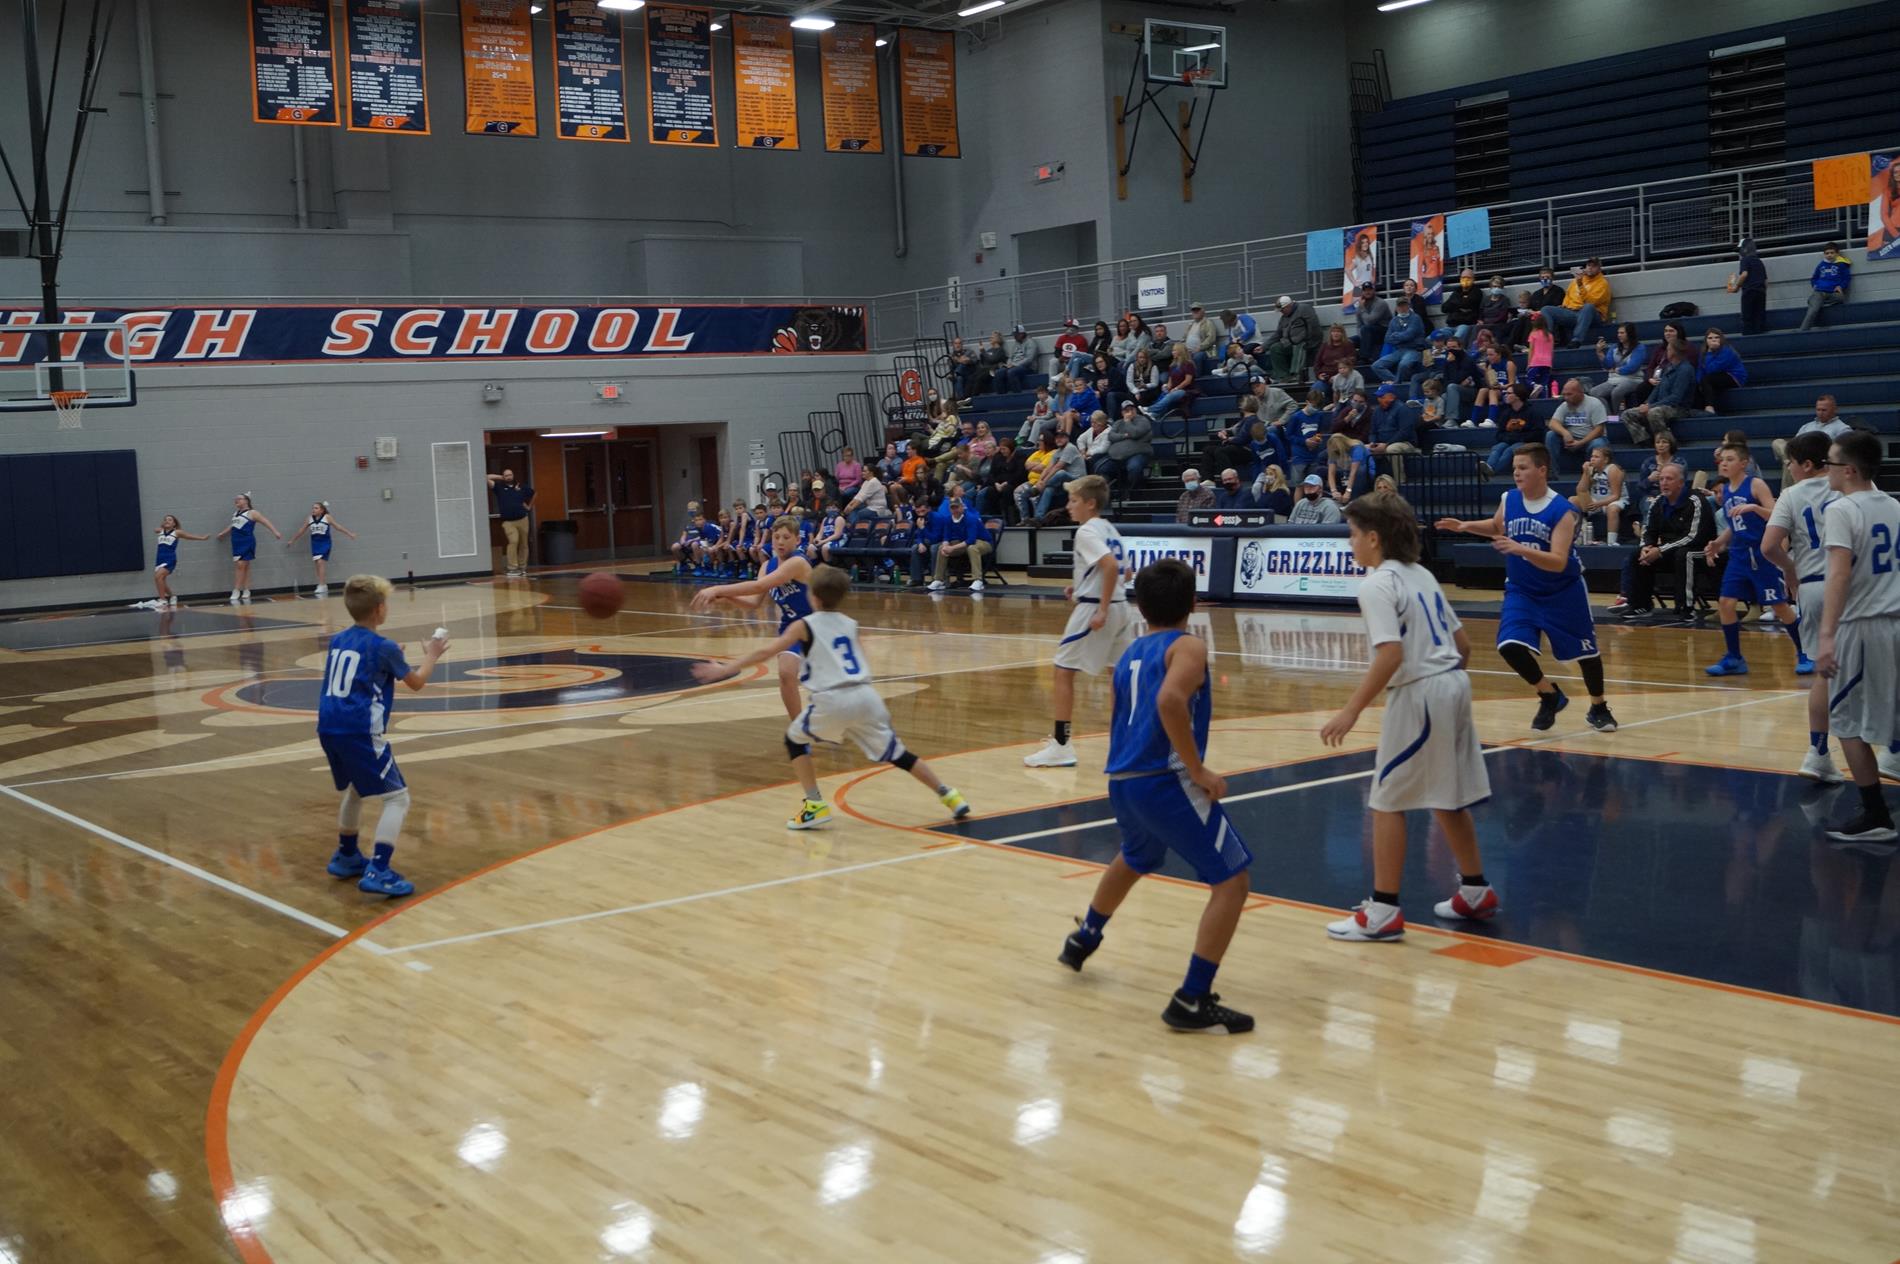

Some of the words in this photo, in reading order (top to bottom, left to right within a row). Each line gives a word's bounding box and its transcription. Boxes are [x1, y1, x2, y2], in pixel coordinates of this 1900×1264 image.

[1140, 287, 1165, 296] VISITORS
[321, 308, 696, 356] SCHOOL
[1764, 588, 1778, 601] R
[832, 635, 861, 675] 3
[1582, 639, 1595, 651] R
[326, 648, 361, 698] 10
[1128, 659, 1142, 706] 1
